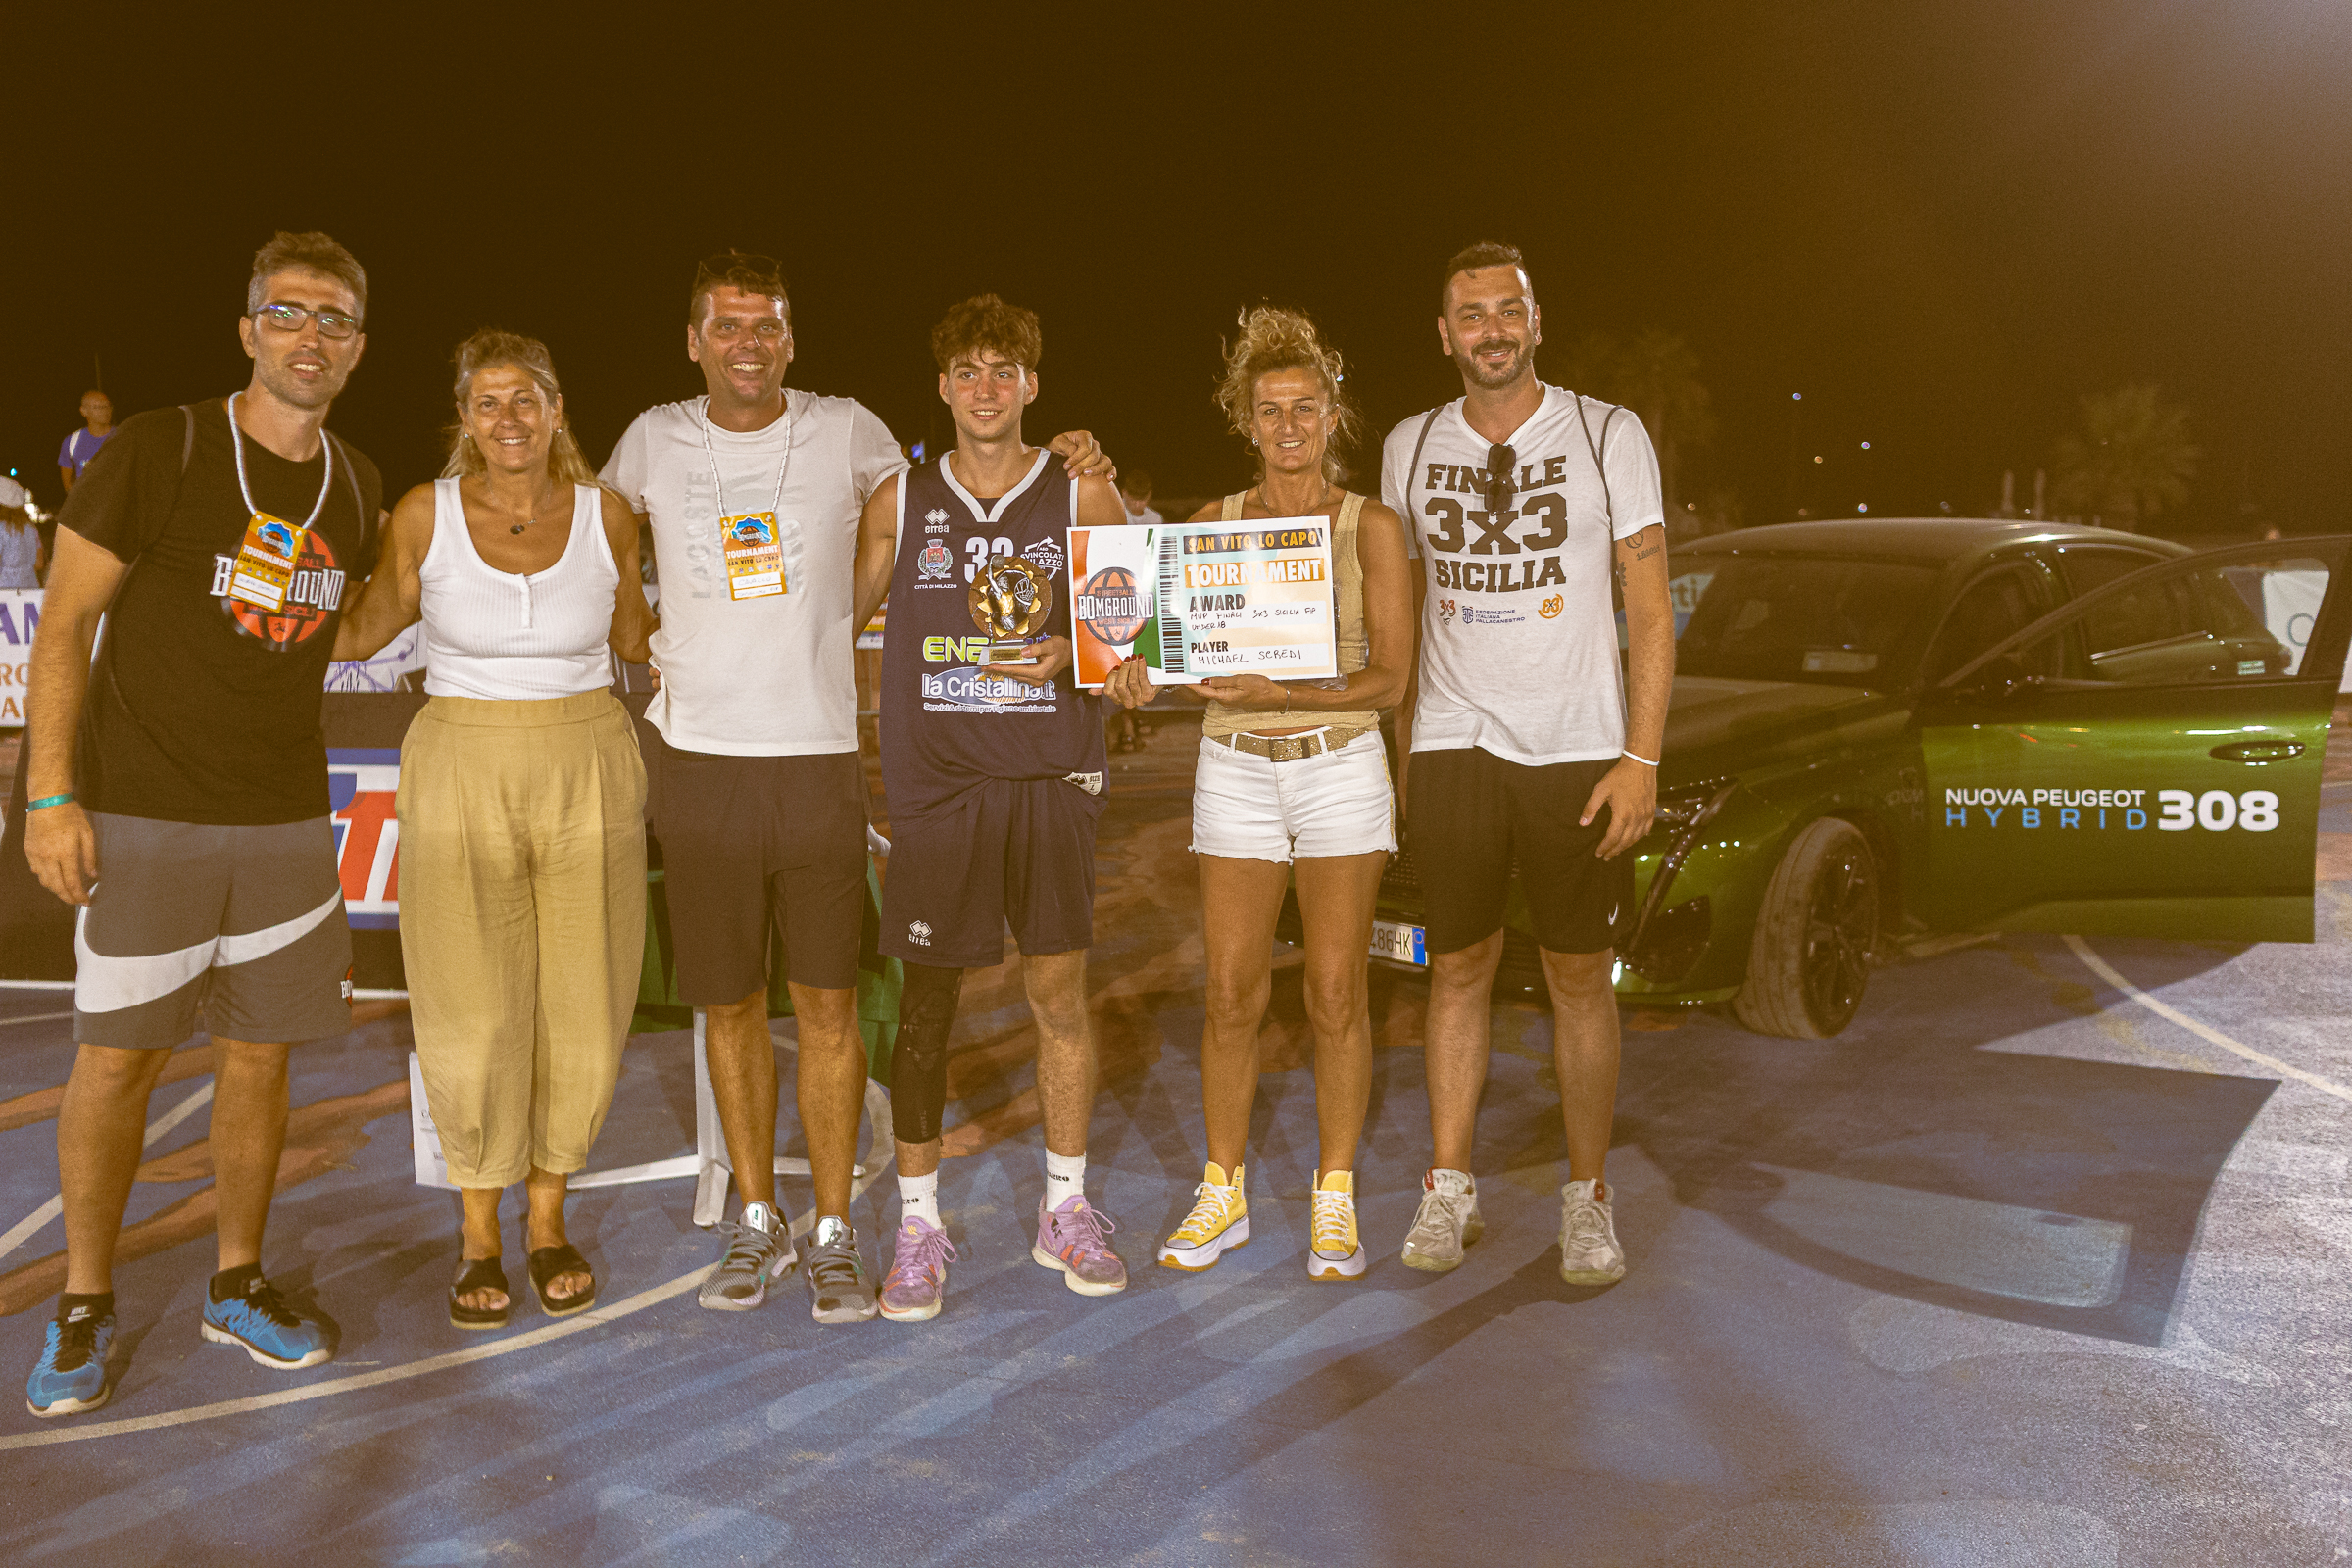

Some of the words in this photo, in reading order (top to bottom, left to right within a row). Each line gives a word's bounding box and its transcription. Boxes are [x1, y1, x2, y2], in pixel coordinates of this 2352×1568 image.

[1425, 455, 1567, 494] FINALE
[726, 545, 779, 559] TOURNAMENT
[1188, 537, 1215, 552] SAN
[1221, 534, 1252, 550] VITO
[1258, 533, 1274, 548] LO
[1281, 530, 1317, 546] CAPO
[243, 544, 294, 570] TOURNAMENT
[1020, 552, 1064, 561] SVINCOLATI
[1188, 560, 1321, 586] TOURNAMENT
[1435, 556, 1567, 593] SICILIA
[1078, 593, 1154, 620] BOMGROUND
[1189, 593, 1246, 612] AWARD
[1191, 641, 1229, 653] PLAYER
[1198, 653, 1249, 665] MICHAEL
[923, 674, 943, 697] la
[924, 703, 948, 711] Servizi
[1946, 789, 2027, 806] NUOVA
[2034, 789, 2146, 807] PEUGEOT
[2157, 789, 2280, 832] 308
[1946, 807, 2147, 830] HYBRID
